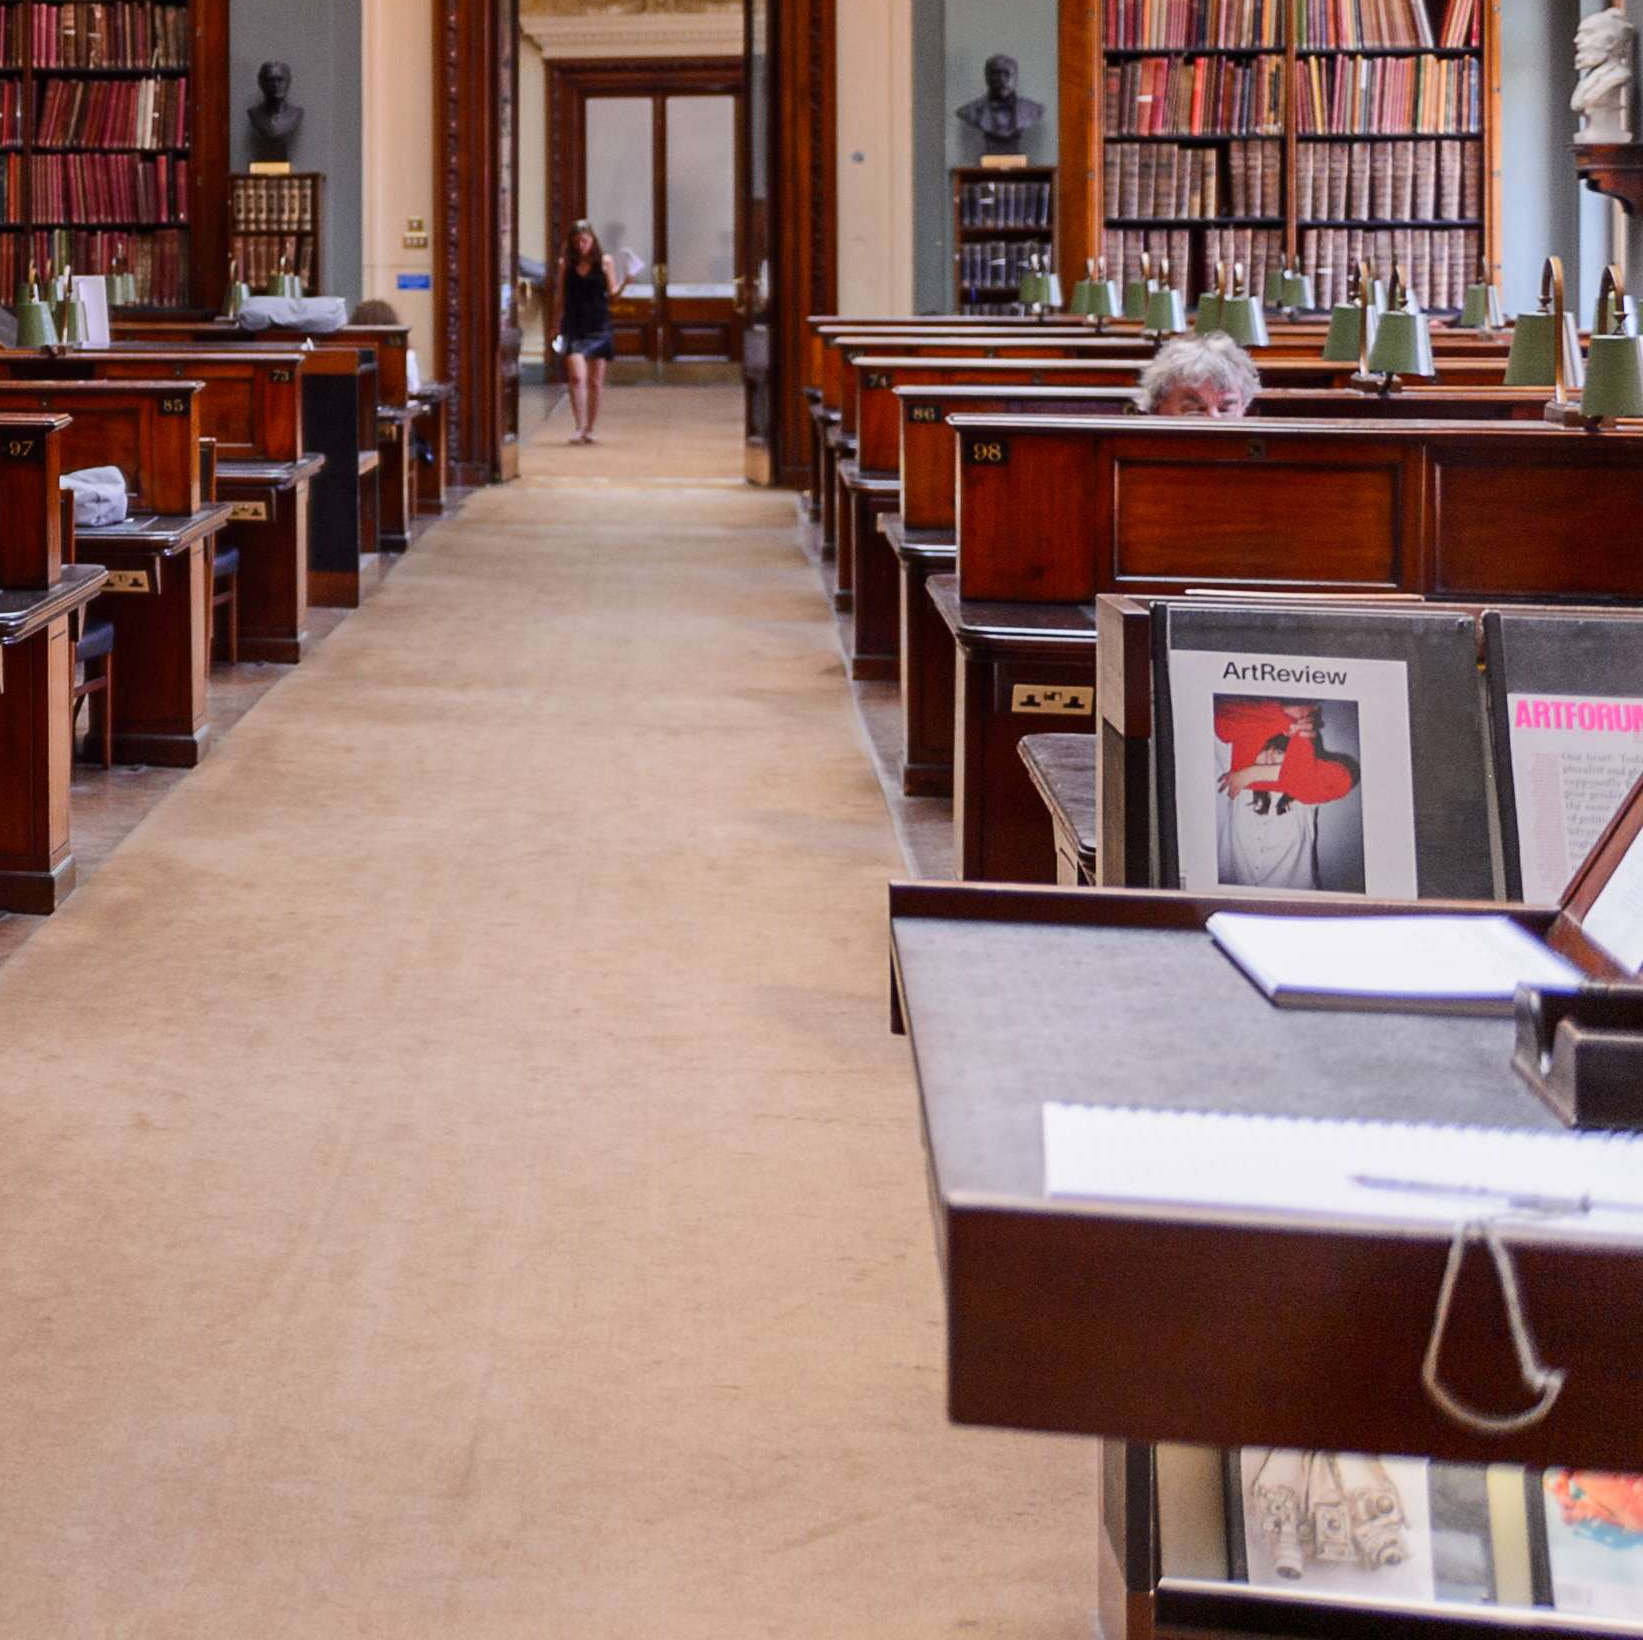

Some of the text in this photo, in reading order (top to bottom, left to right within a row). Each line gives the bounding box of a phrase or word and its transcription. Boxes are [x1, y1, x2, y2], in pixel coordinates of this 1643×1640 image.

[9, 440, 35, 456] 97
[973, 442, 1002, 461] 98
[1222, 660, 1348, 687] ArtReview
